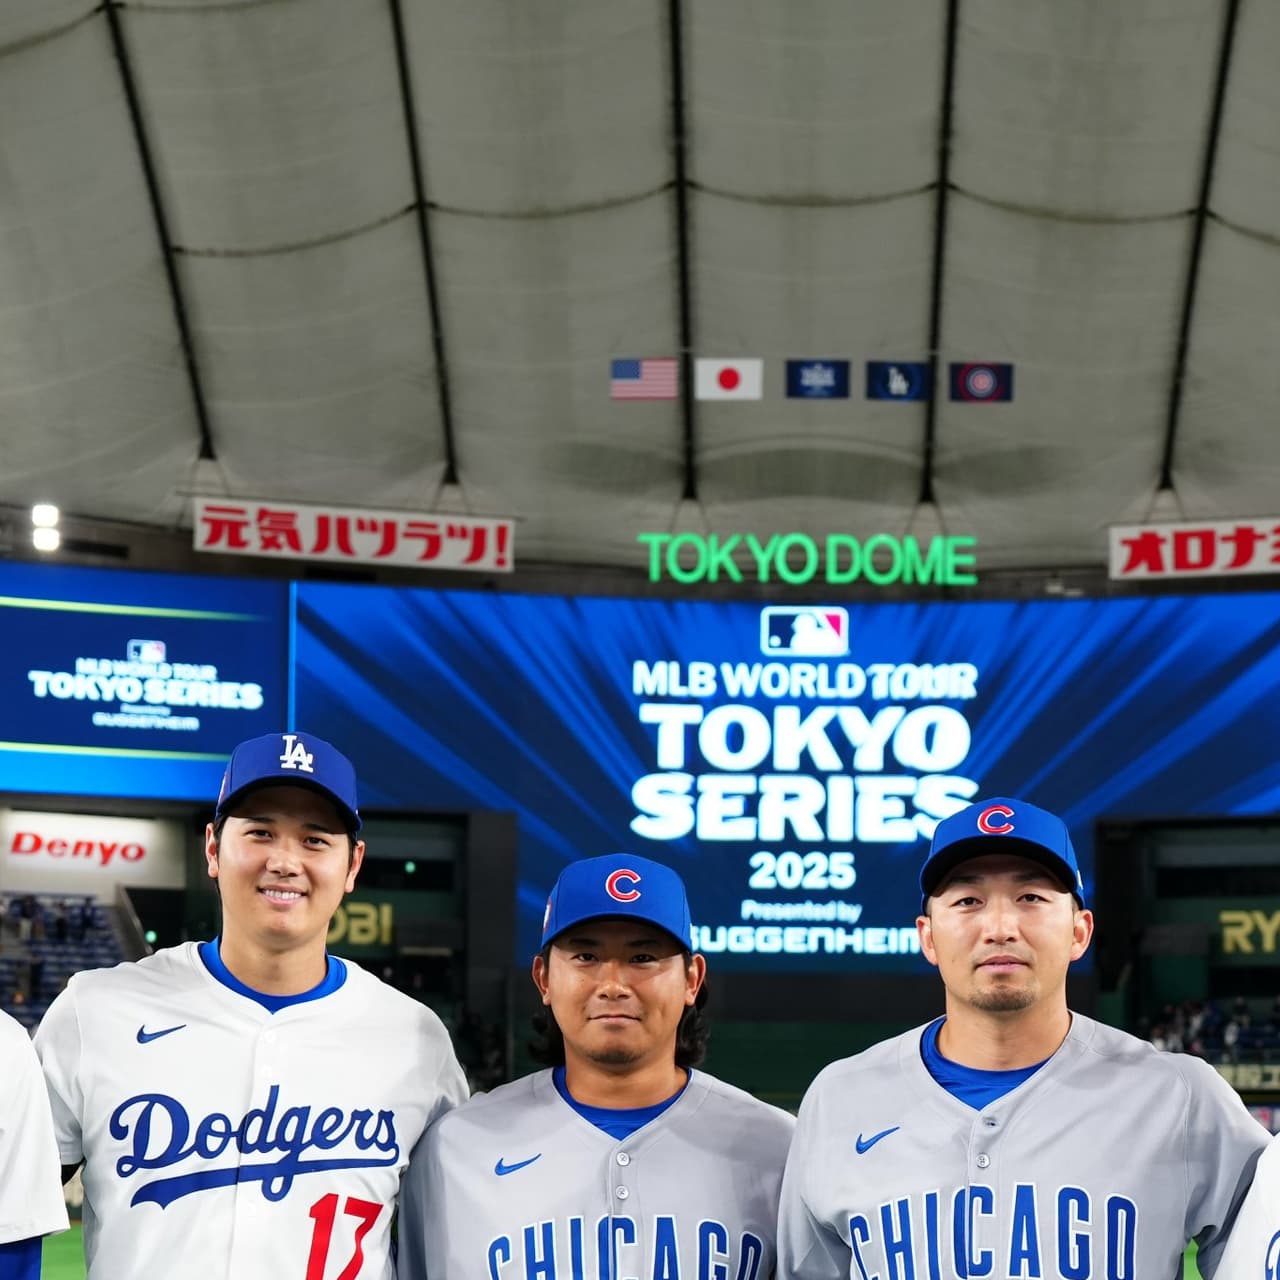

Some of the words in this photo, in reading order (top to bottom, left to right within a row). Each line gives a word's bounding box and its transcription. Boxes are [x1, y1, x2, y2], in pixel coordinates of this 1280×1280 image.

[638, 532, 820, 586] TOKYO
[824, 533, 978, 586] DOME
[28, 670, 143, 703] TOKYO
[144, 677, 263, 710] SERIES
[633, 660, 717, 697] MLB
[721, 662, 867, 698] WORLD
[869, 663, 978, 699] TOUR
[279, 734, 314, 773] LA
[639, 703, 971, 772] TOKYO
[630, 772, 979, 843] SERIES
[977, 804, 1015, 834] C
[11, 831, 146, 867] Denyo
[606, 868, 641, 902] C
[748, 851, 857, 889] 2025
[741, 899, 835, 921] Presented
[836, 900, 862, 924] by
[110, 1085, 400, 1209] Dodgers
